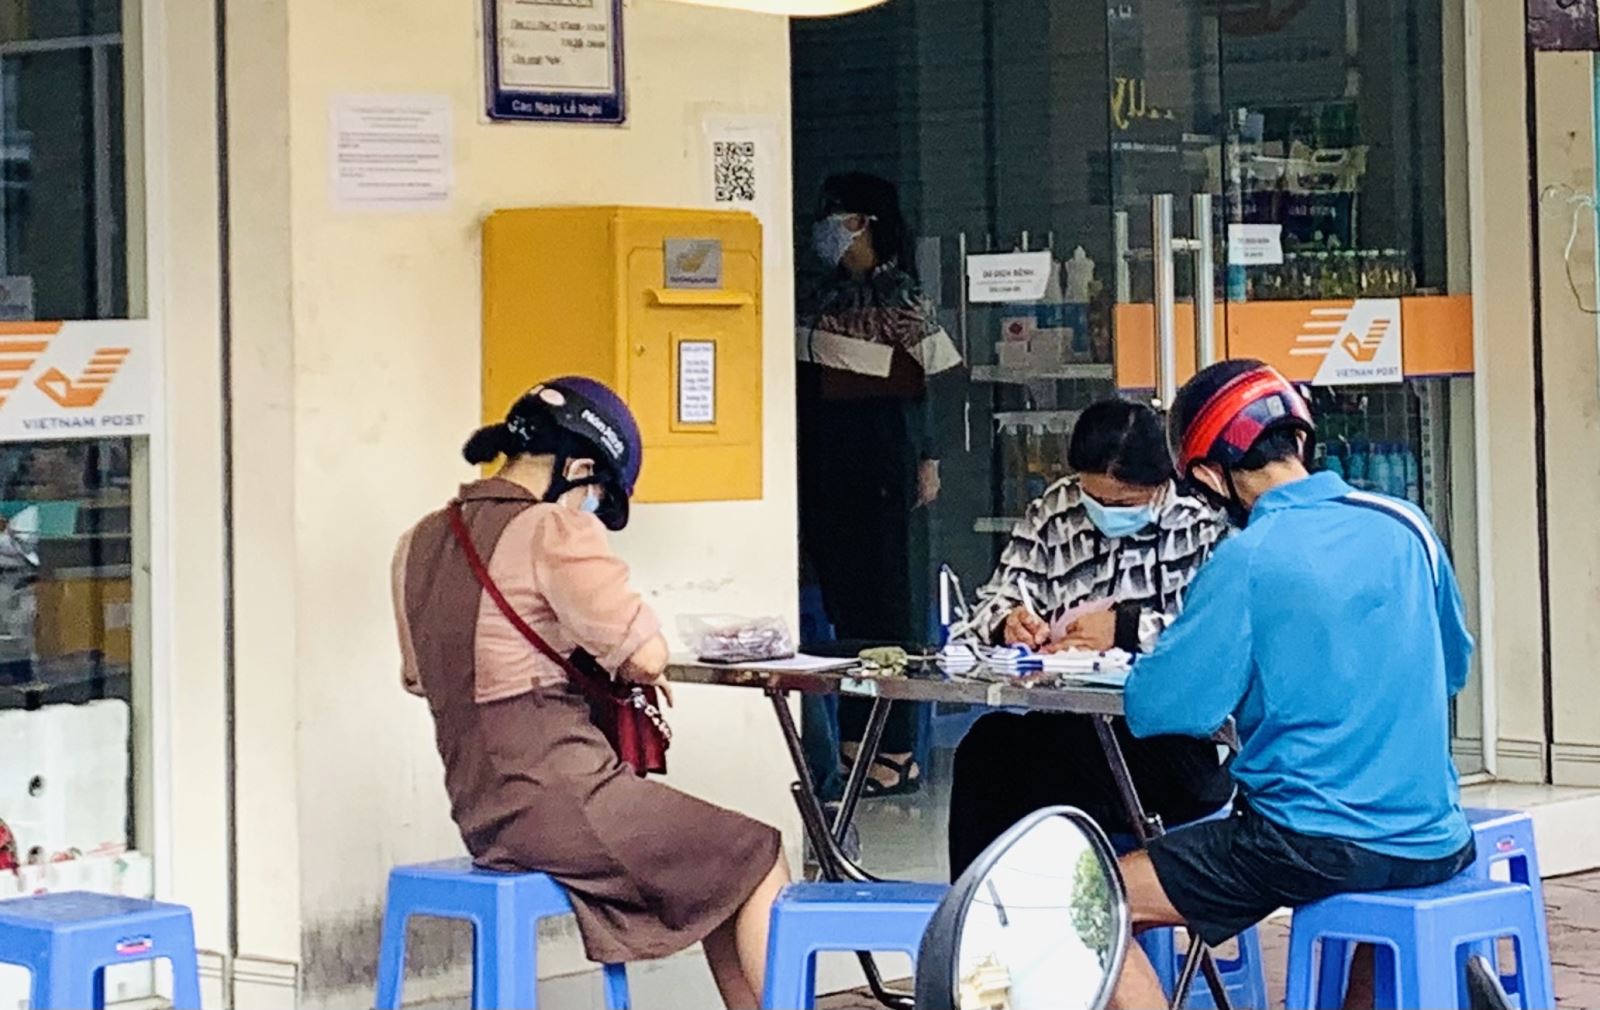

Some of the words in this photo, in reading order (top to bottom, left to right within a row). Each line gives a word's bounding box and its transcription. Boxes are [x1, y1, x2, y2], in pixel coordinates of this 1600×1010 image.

[1336, 368, 1373, 377] VIETNAM
[1376, 367, 1398, 376] POST
[22, 416, 96, 430] VIETNAM
[101, 414, 145, 427] POST
